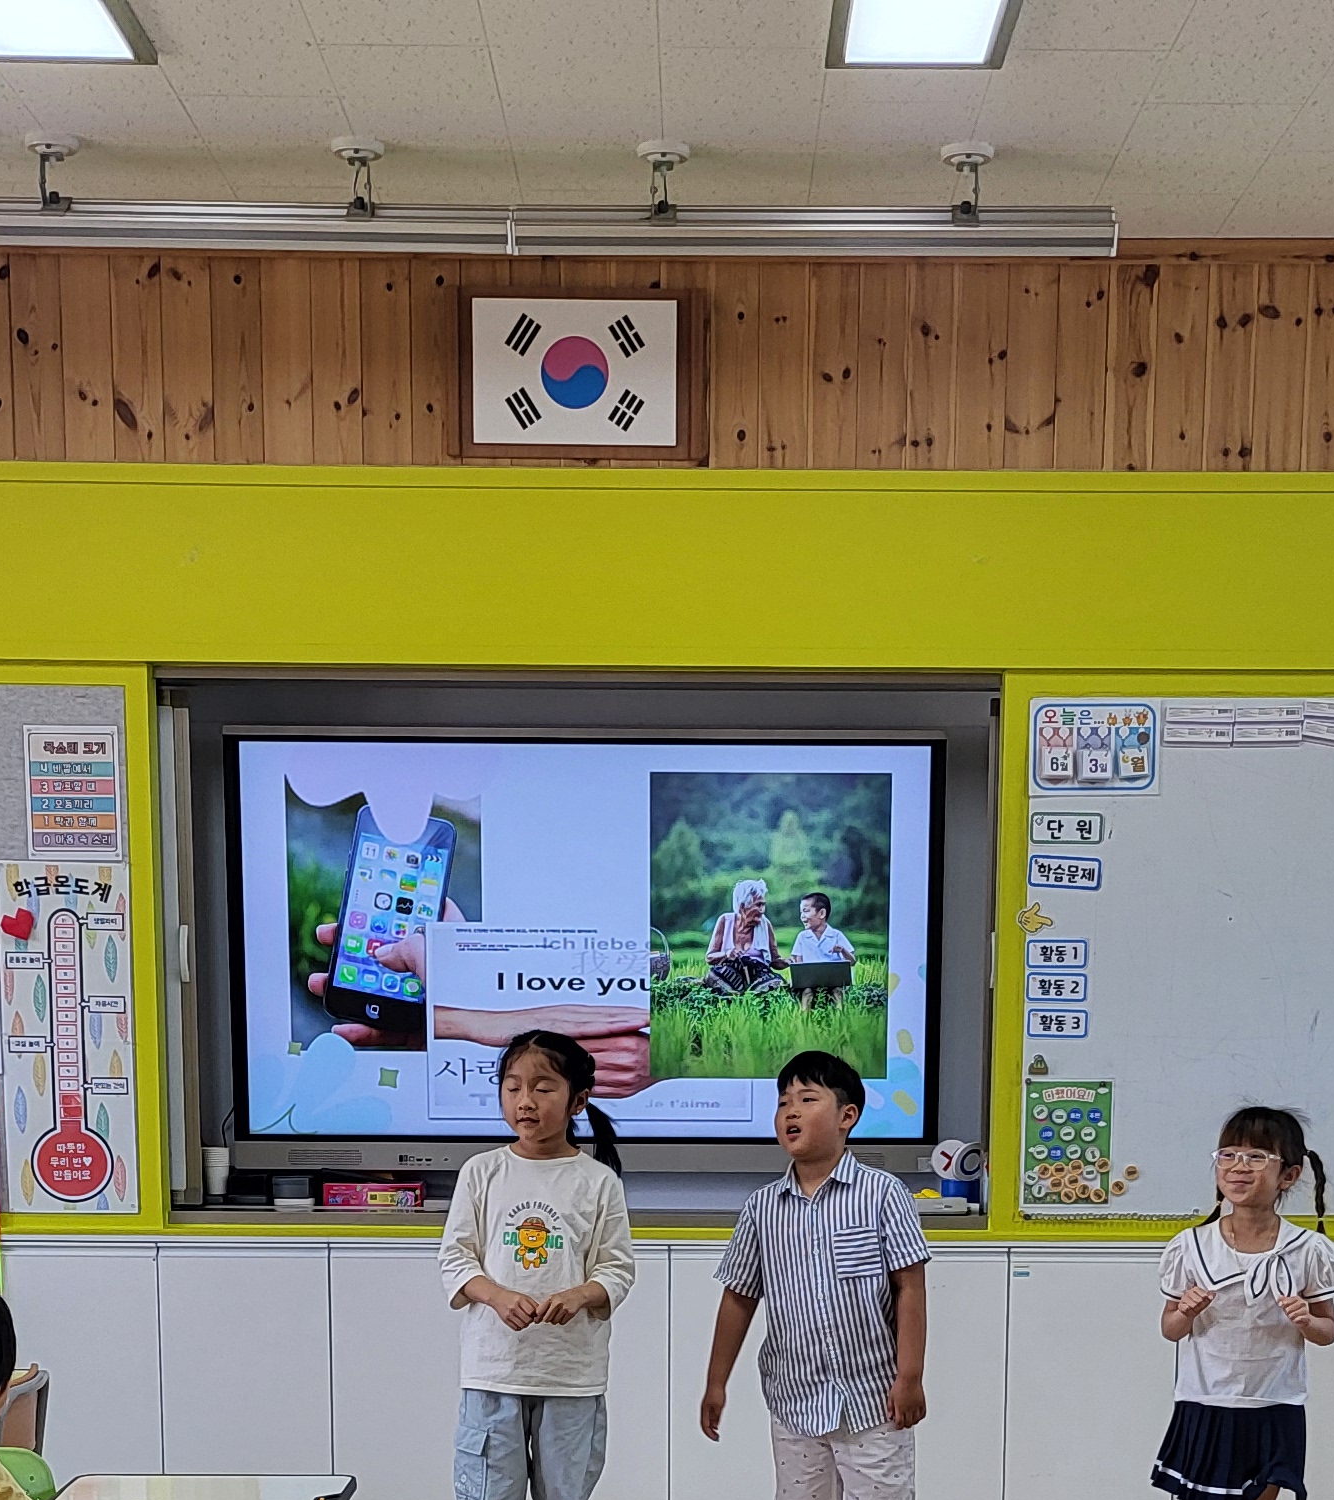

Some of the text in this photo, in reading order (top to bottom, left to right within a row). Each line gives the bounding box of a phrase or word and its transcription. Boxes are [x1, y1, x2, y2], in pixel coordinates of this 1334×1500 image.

[43, 741, 107, 754] 목소리 크기
[40, 764, 47, 773] 4
[1050, 756, 1145, 773] 6월 3일 월
[41, 782, 48, 792] 3
[42, 800, 49, 809] 2
[44, 816, 48, 825] 1
[1046, 819, 1092, 840] 단 원
[56, 834, 74, 844] 마음
[78, 835, 89, 844] 속
[92, 835, 111, 845] 소리
[1038, 863, 1095, 883] 학습문제
[13, 875, 112, 903] 학급온도계
[583, 936, 637, 950] liebe
[1039, 946, 1078, 962] 활동 1
[498, 973, 650, 996] I love you
[1037, 979, 1079, 996] 활동 2
[1039, 1015, 1081, 1032] 활동 3
[50, 1157, 83, 1167] 우리 반
[508, 1201, 560, 1222] KAKAO FRIENDS
